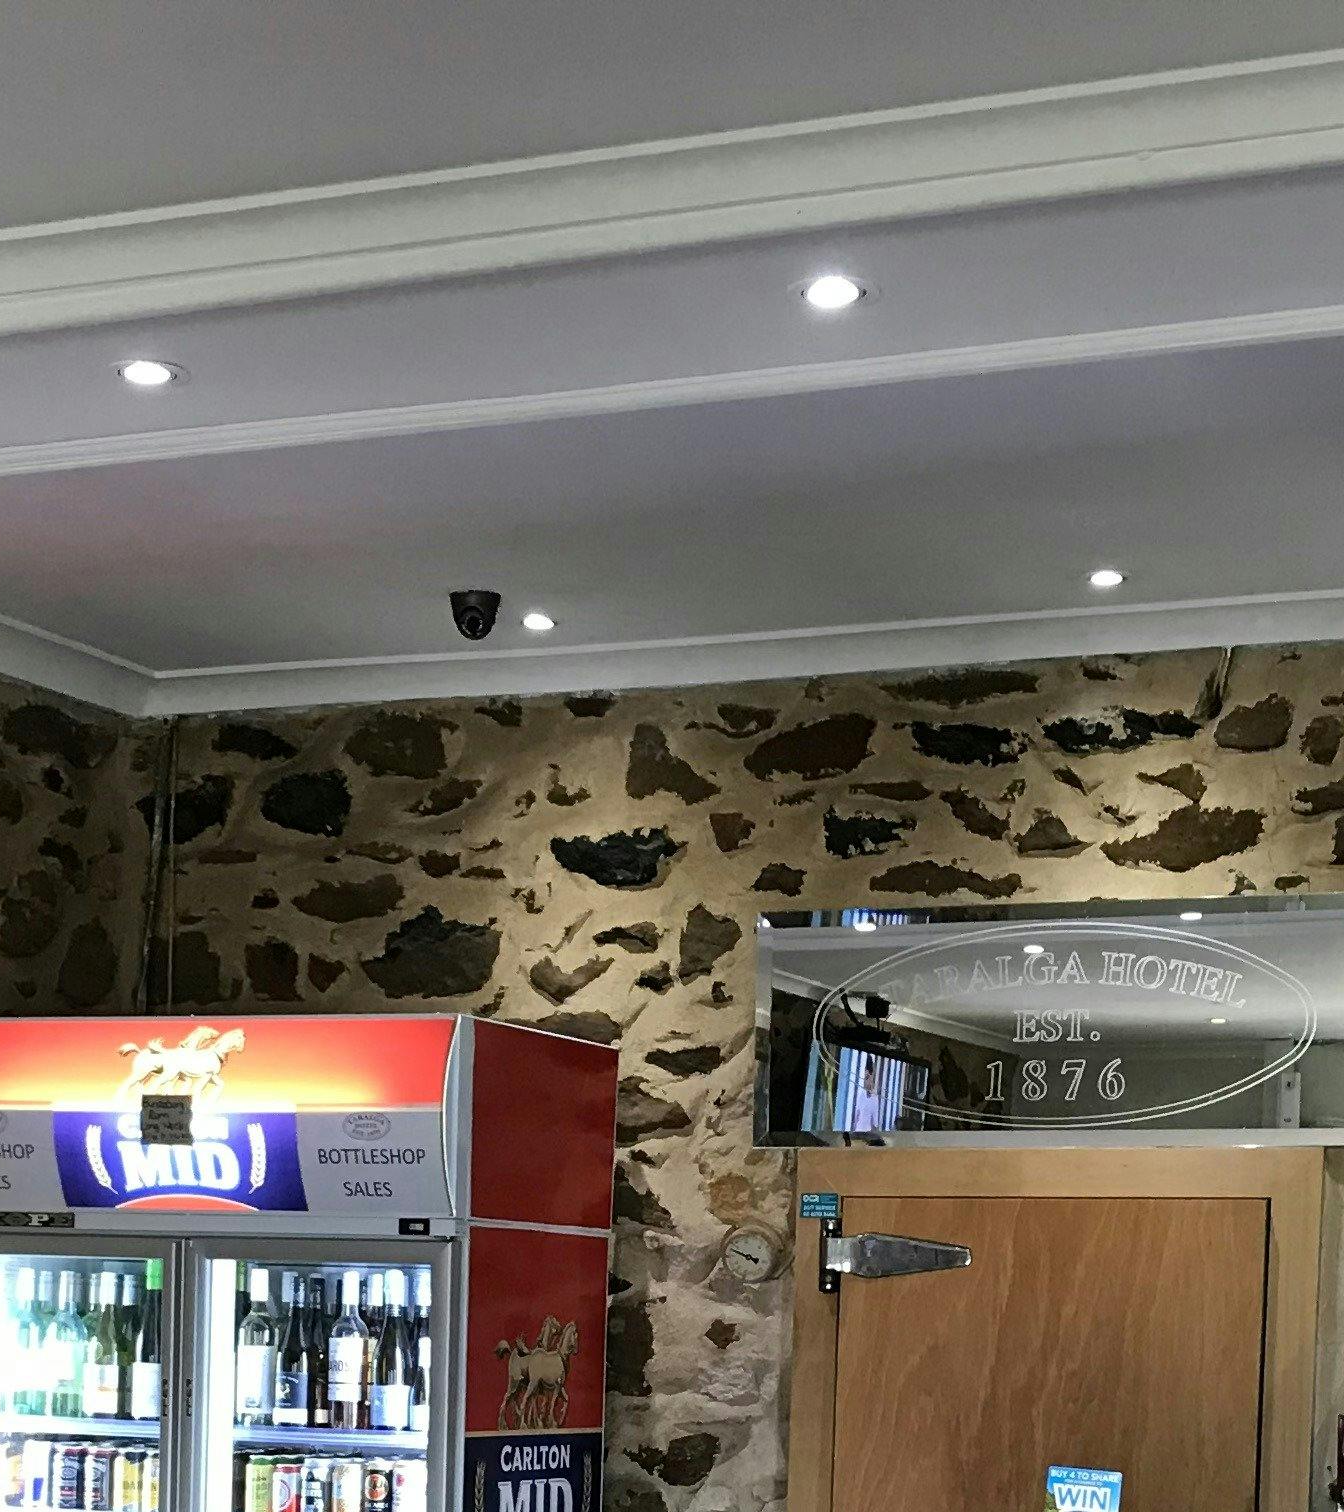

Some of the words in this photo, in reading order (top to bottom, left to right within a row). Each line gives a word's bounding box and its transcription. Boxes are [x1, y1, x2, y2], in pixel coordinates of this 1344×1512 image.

[1099, 951, 1247, 1008] HOTEL
[1012, 1009, 1101, 1043] EST.
[985, 1058, 1126, 1101] 1876
[116, 1139, 240, 1193] MID
[317, 1148, 426, 1165] BOTTLESHOP
[342, 1181, 393, 1197] SALES
[500, 1444, 570, 1472] CARLTON
[1058, 1486, 1108, 1510] WIN
